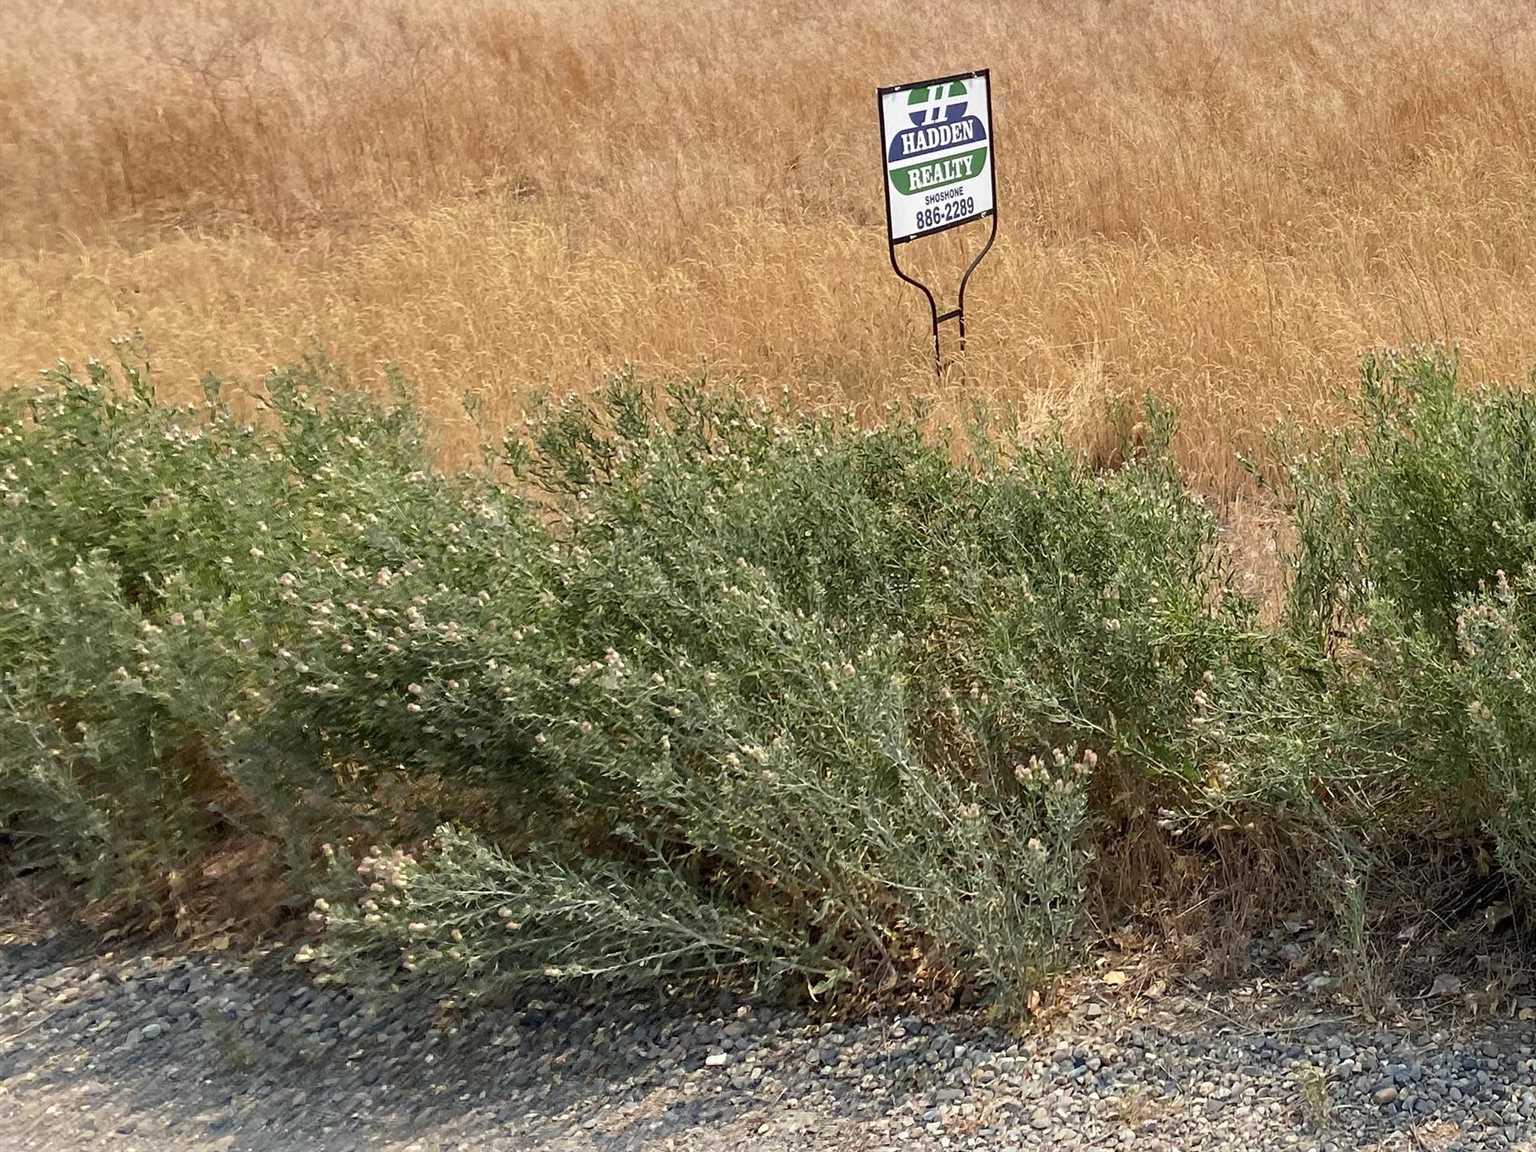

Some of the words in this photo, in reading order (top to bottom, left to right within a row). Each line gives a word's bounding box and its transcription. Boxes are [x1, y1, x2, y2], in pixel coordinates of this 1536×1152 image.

[901, 120, 974, 155] HADDEN
[908, 155, 974, 191] REALTY
[916, 197, 975, 230] 886-2289
[925, 187, 964, 206] SHOSHONE
